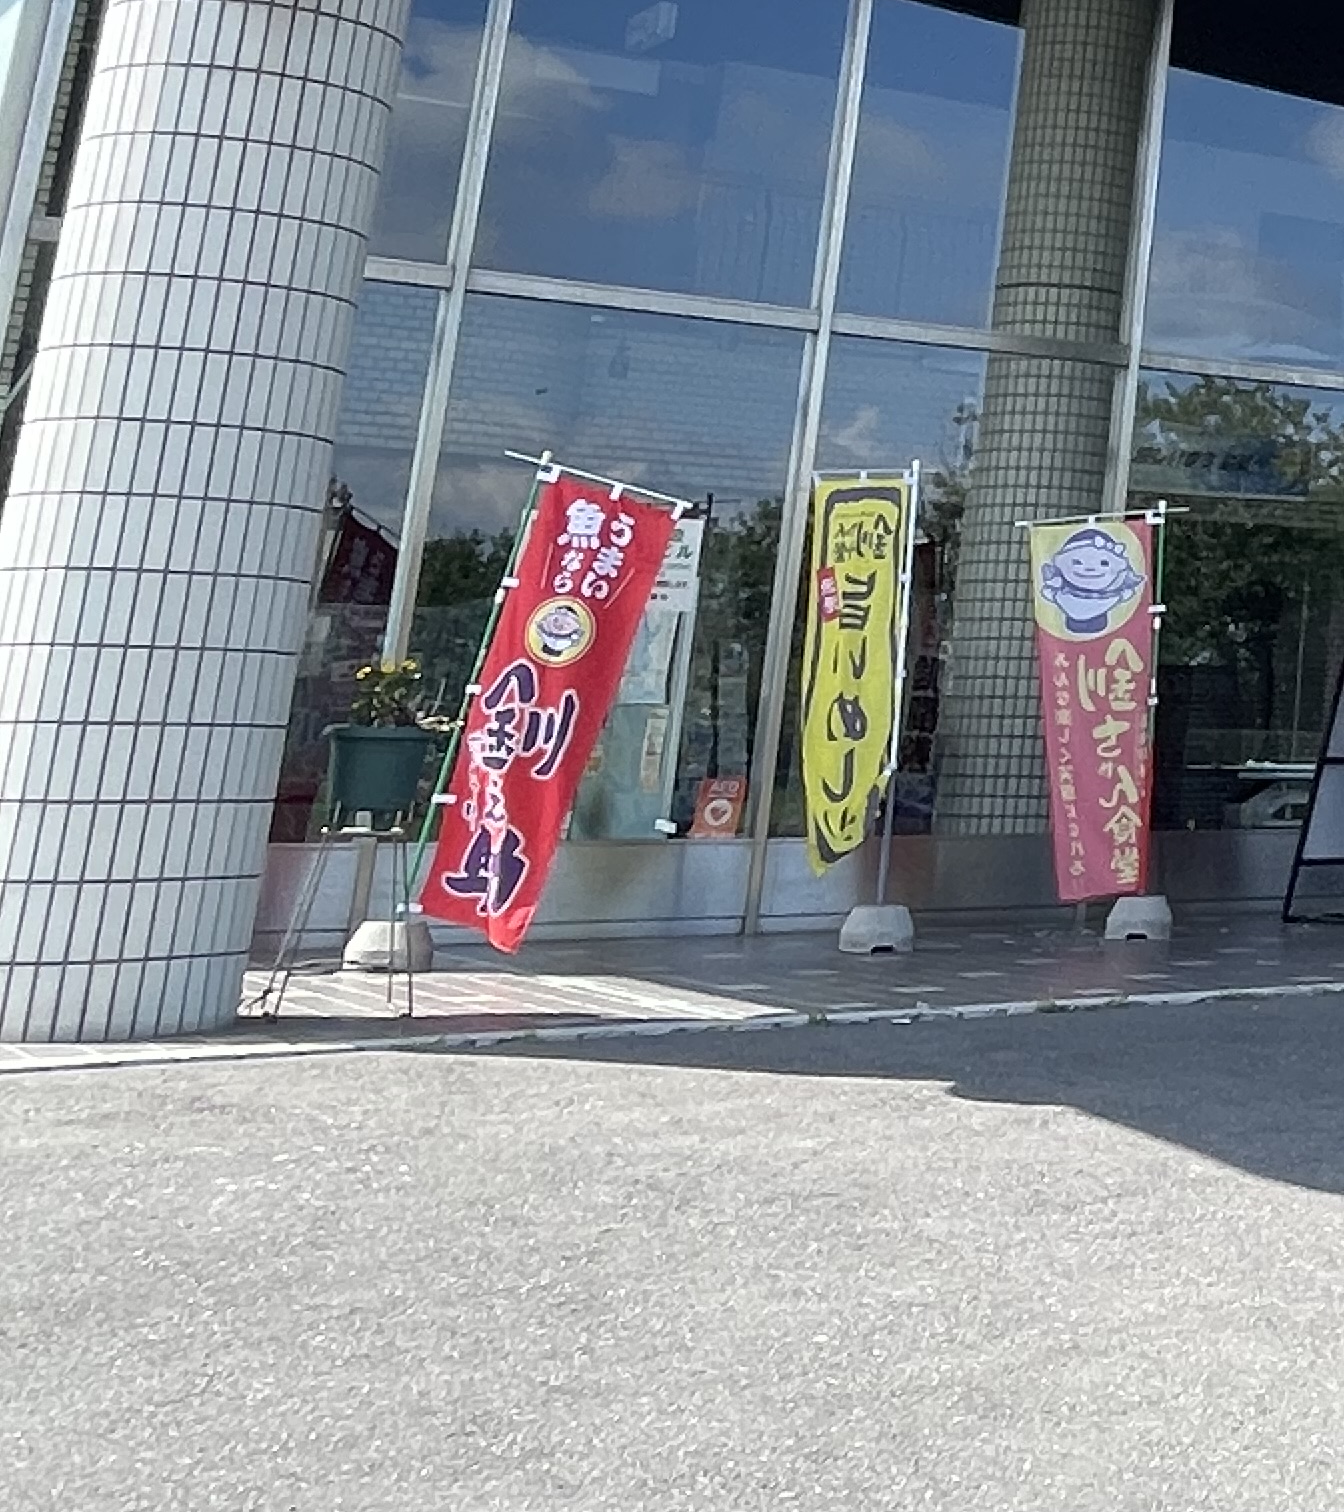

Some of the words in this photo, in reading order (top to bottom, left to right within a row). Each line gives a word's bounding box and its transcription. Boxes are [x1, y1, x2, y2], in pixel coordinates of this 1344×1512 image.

[552, 498, 606, 595] 魚なら
[582, 511, 637, 600] うまい
